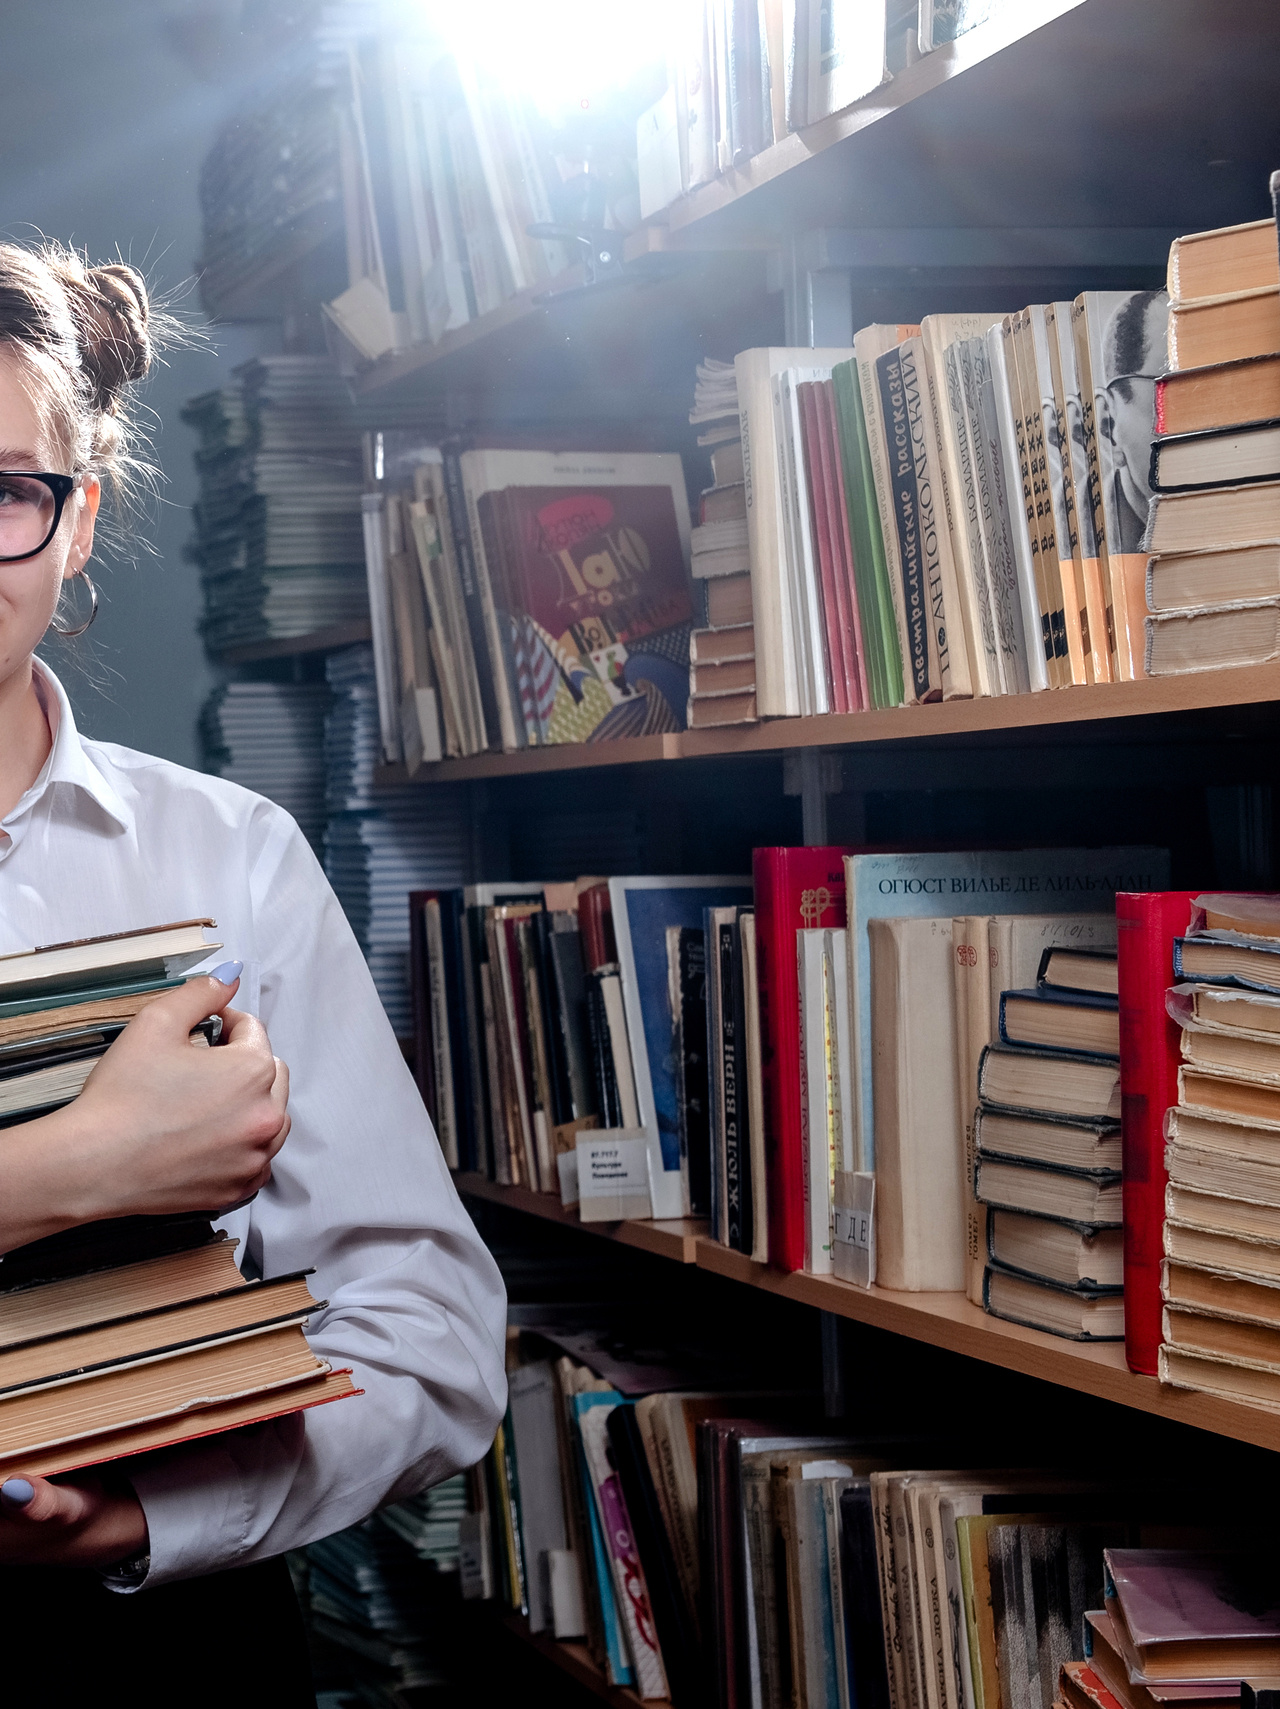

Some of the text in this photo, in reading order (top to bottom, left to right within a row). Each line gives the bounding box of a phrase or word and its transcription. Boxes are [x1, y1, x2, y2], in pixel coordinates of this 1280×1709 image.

[861, 360, 875, 416] КЛЮЧИКОМ
[740, 409, 753, 490] БАЛЬЗАК
[900, 349, 946, 621] АНТОКОЛЬСКИЙ
[956, 417, 978, 523] БОМАРШЕ
[971, 414, 993, 521] БОМАРШЕ
[1016, 419, 1033, 519] БРЕХТ
[1025, 416, 1045, 517] БРЕХТ
[1032, 412, 1051, 515] БРЕХТ
[1056, 409, 1074, 514] БРЕХТ
[1082, 402, 1102, 512] БРЕХТ
[885, 361, 925, 685] австралийские рассказы
[878, 877, 947, 895] ОГЮСТ
[950, 877, 1011, 894] ВИЛЬЕ
[1013, 876, 1040, 895] ДЕ
[723, 1042, 740, 1210] ЖЮЛЬ ВЕРН
[901, 1565, 914, 1627] ЛОРКА
[930, 1577, 948, 1709] АРСИА ЛОРКА
[919, 1642, 928, 1709] АРСИА
